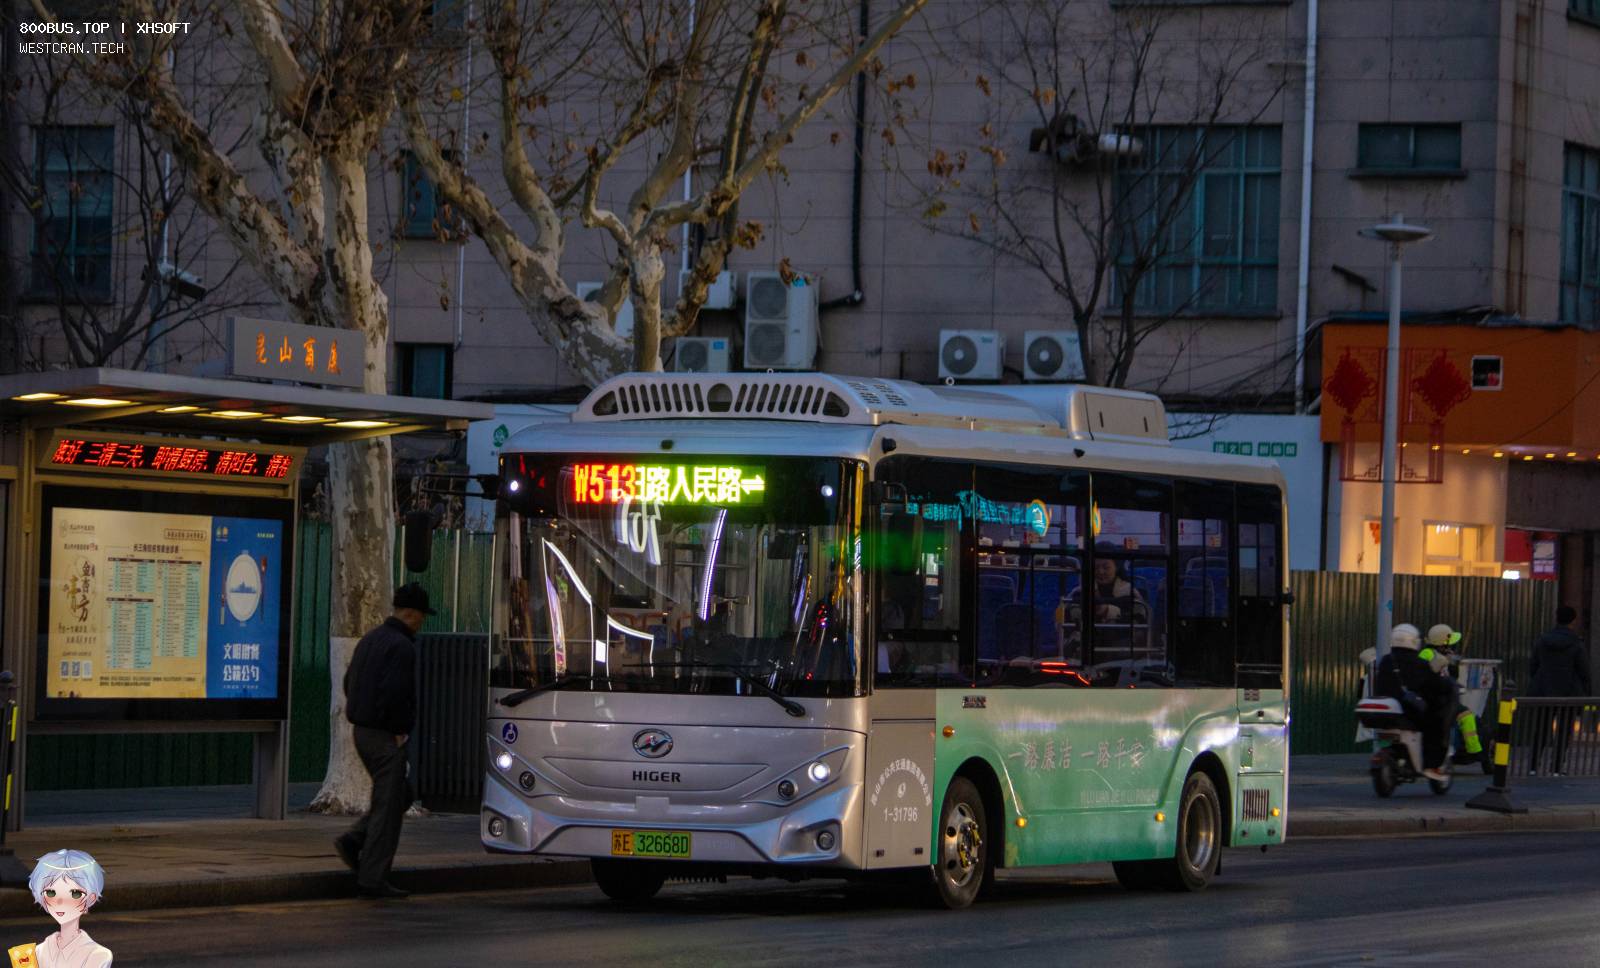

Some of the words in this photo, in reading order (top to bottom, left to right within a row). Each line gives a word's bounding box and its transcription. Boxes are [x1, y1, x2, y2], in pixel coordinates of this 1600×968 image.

[573, 464, 636, 503] W513
[1007, 737, 1073, 769] 一路廉洁
[1080, 736, 1145, 769] 一路平安
[632, 769, 681, 783] HIGER
[883, 807, 918, 822] 1-31796
[614, 832, 631, 852] 苏E
[637, 834, 689, 854] 32668D
